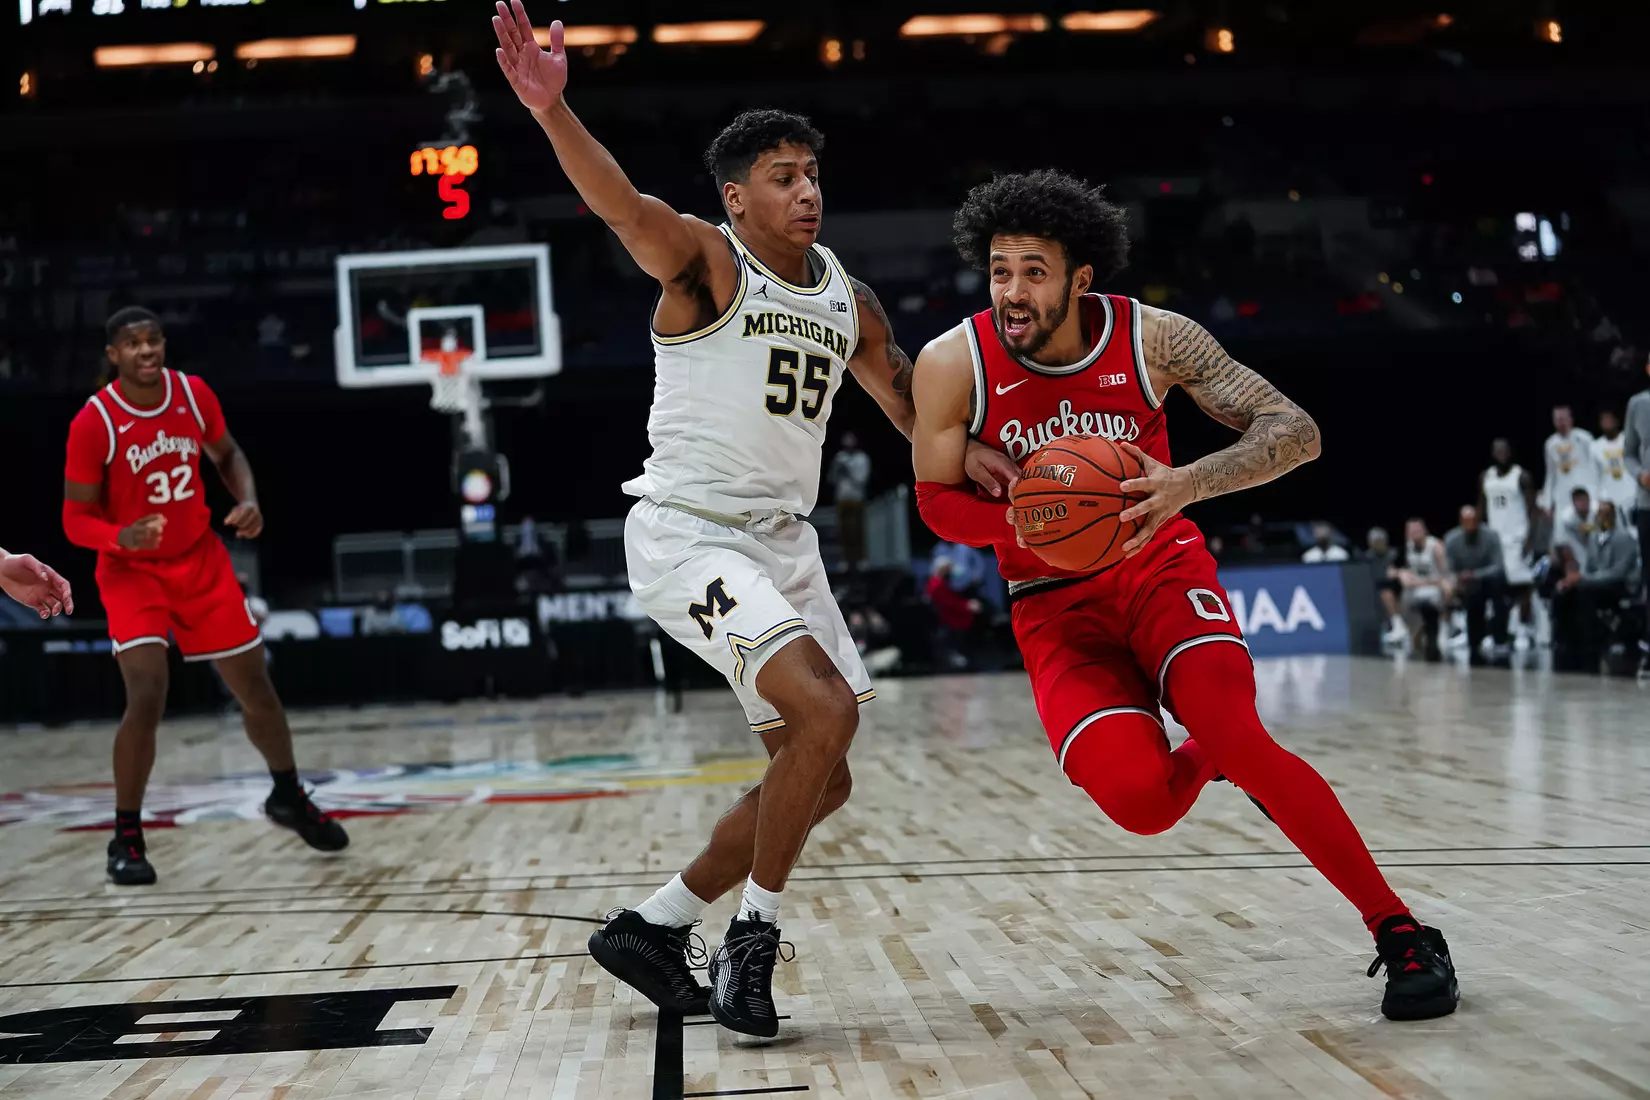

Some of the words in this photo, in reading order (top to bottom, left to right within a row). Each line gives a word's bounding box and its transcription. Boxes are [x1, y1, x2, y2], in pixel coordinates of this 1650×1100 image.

[438, 173, 470, 219] 5
[742, 312, 848, 361] MICHIGAN
[764, 346, 832, 420] 55
[126, 430, 199, 474] Buckeyes
[1000, 399, 1140, 461] Buckeyes
[145, 464, 195, 504] 32
[688, 576, 738, 642] M
[441, 619, 500, 650] SoFi
